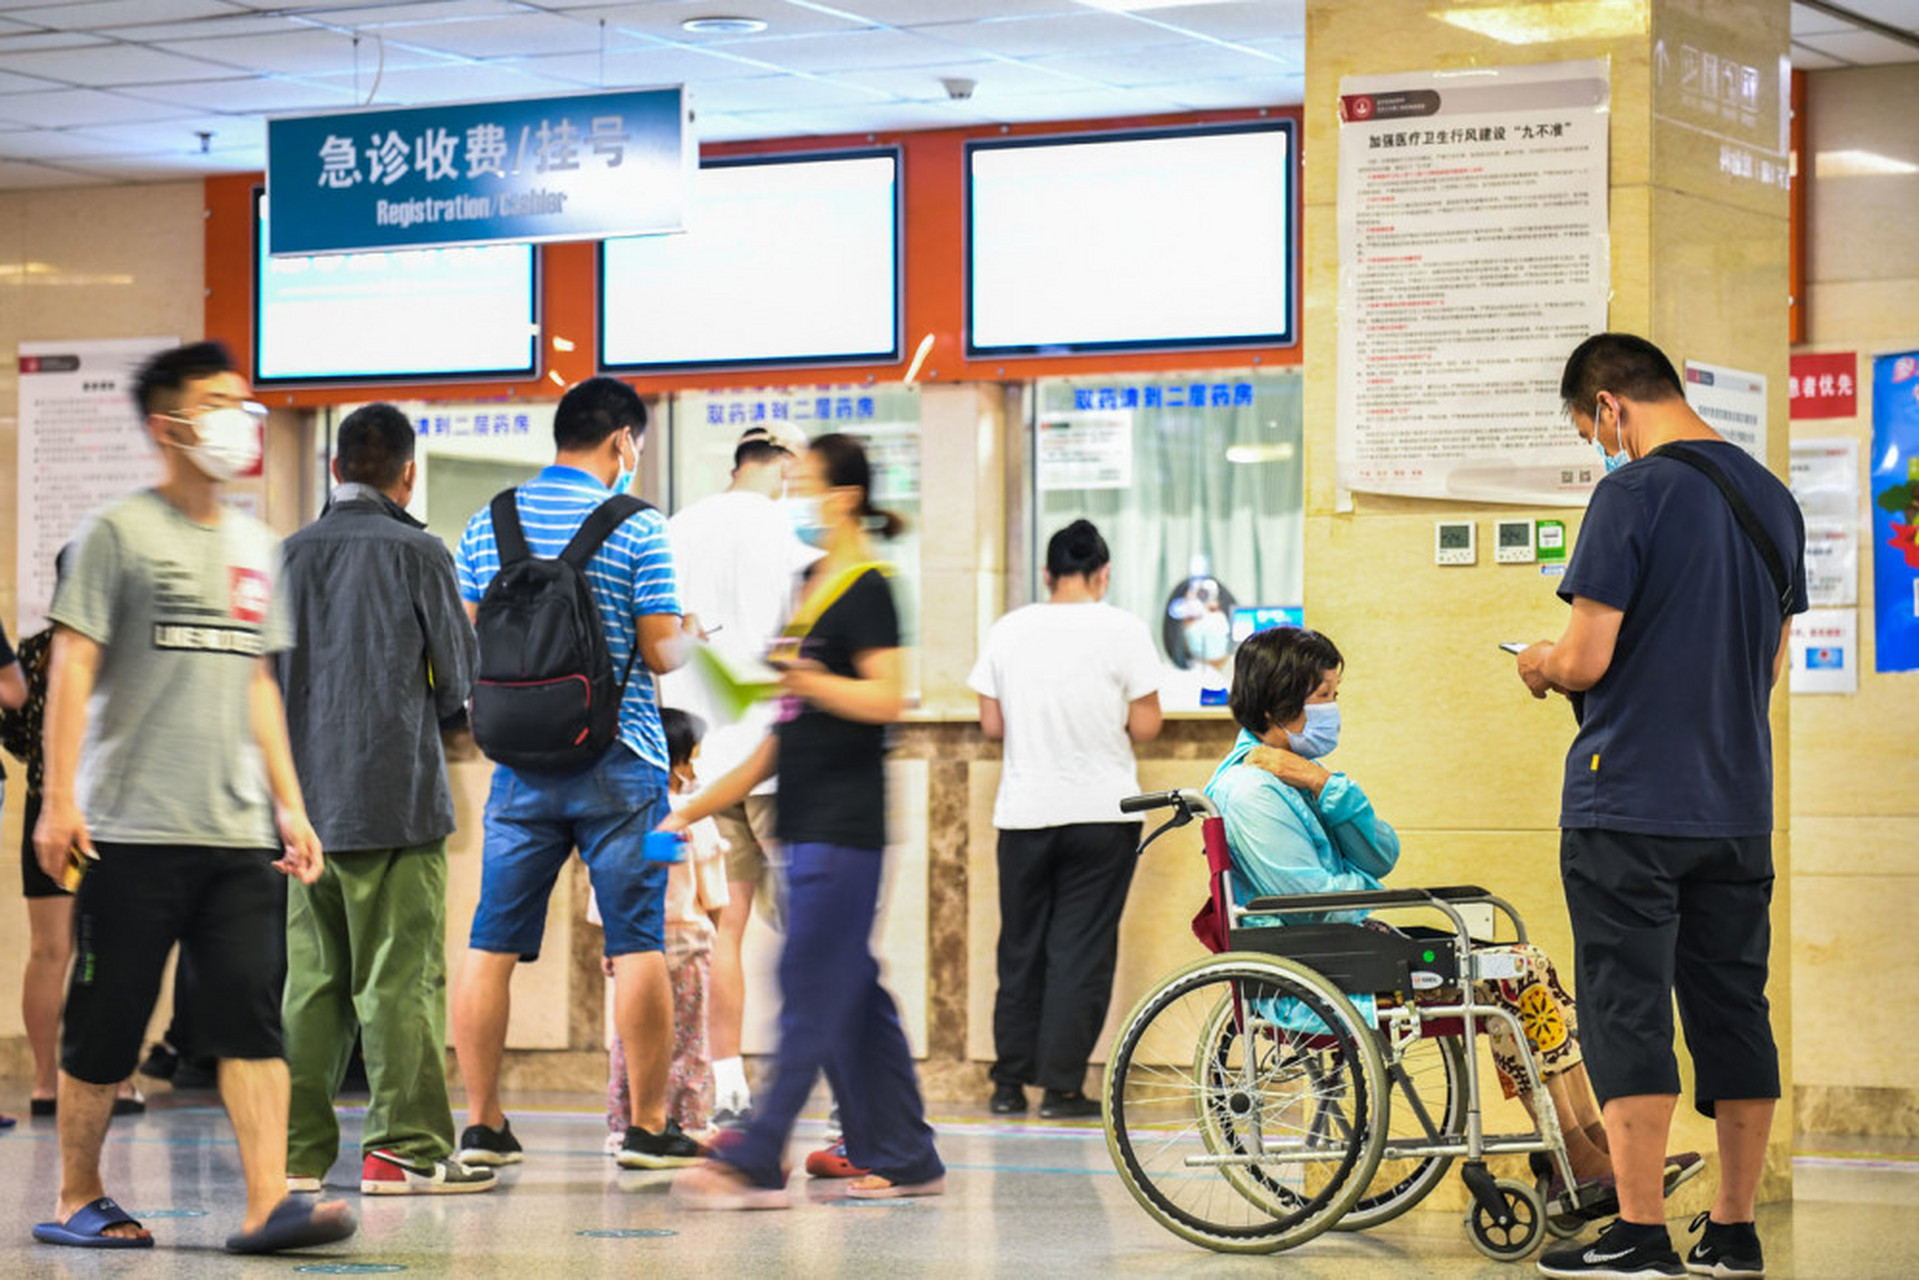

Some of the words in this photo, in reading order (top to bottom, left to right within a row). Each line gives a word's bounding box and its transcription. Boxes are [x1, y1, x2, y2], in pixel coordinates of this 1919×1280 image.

[318, 116, 630, 188] 急诊收费/挂号
[706, 396, 876, 425] 取药请到二层药房
[1074, 383, 1252, 410] 取药请到二层药房
